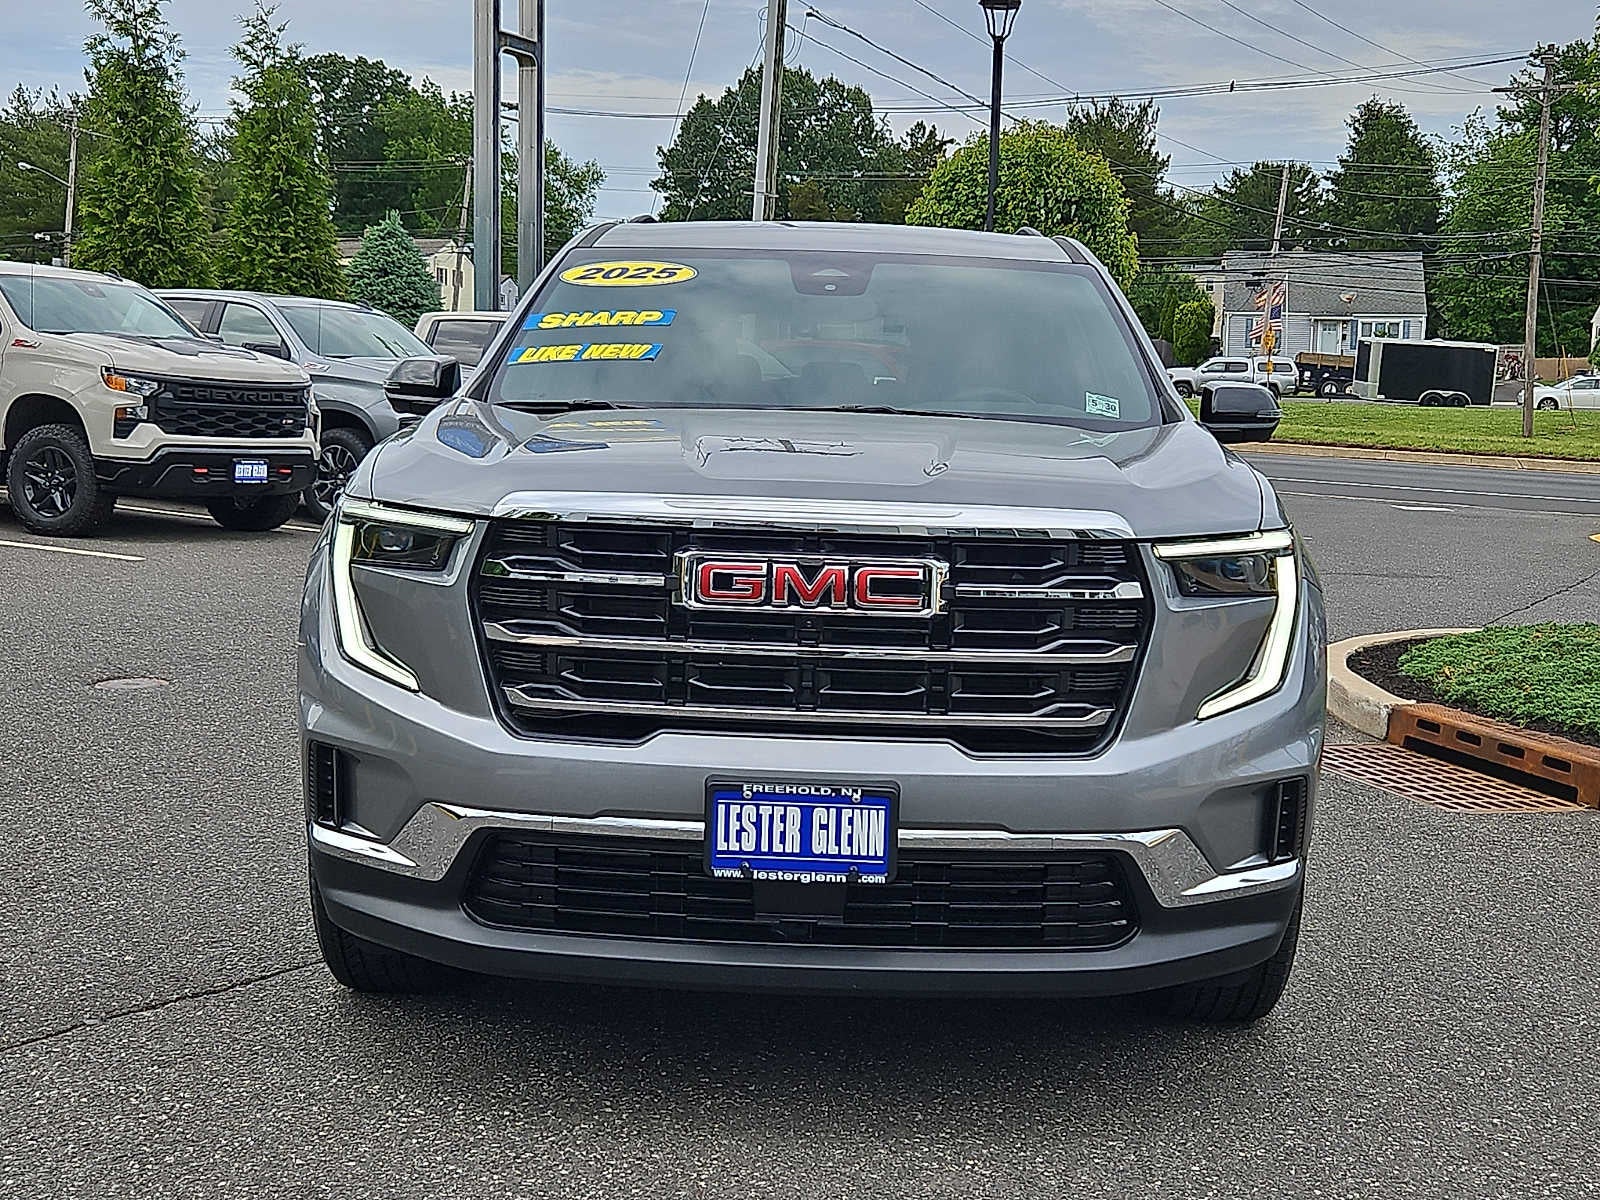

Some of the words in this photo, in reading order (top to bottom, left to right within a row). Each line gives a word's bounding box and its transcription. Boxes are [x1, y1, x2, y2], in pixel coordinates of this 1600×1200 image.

[574, 267, 684, 280] 2025
[537, 310, 664, 329] SHARP
[517, 345, 583, 362] LIKE
[581, 343, 653, 359] NEW
[179, 386, 302, 402] CHEVROLET
[1091, 399, 1098, 407] 5
[698, 561, 924, 608] GMC
[742, 784, 836, 798] FREEHOLD,
[841, 788, 862, 798] NJ
[716, 803, 801, 854] LESTER
[812, 807, 885, 857] GLENN
